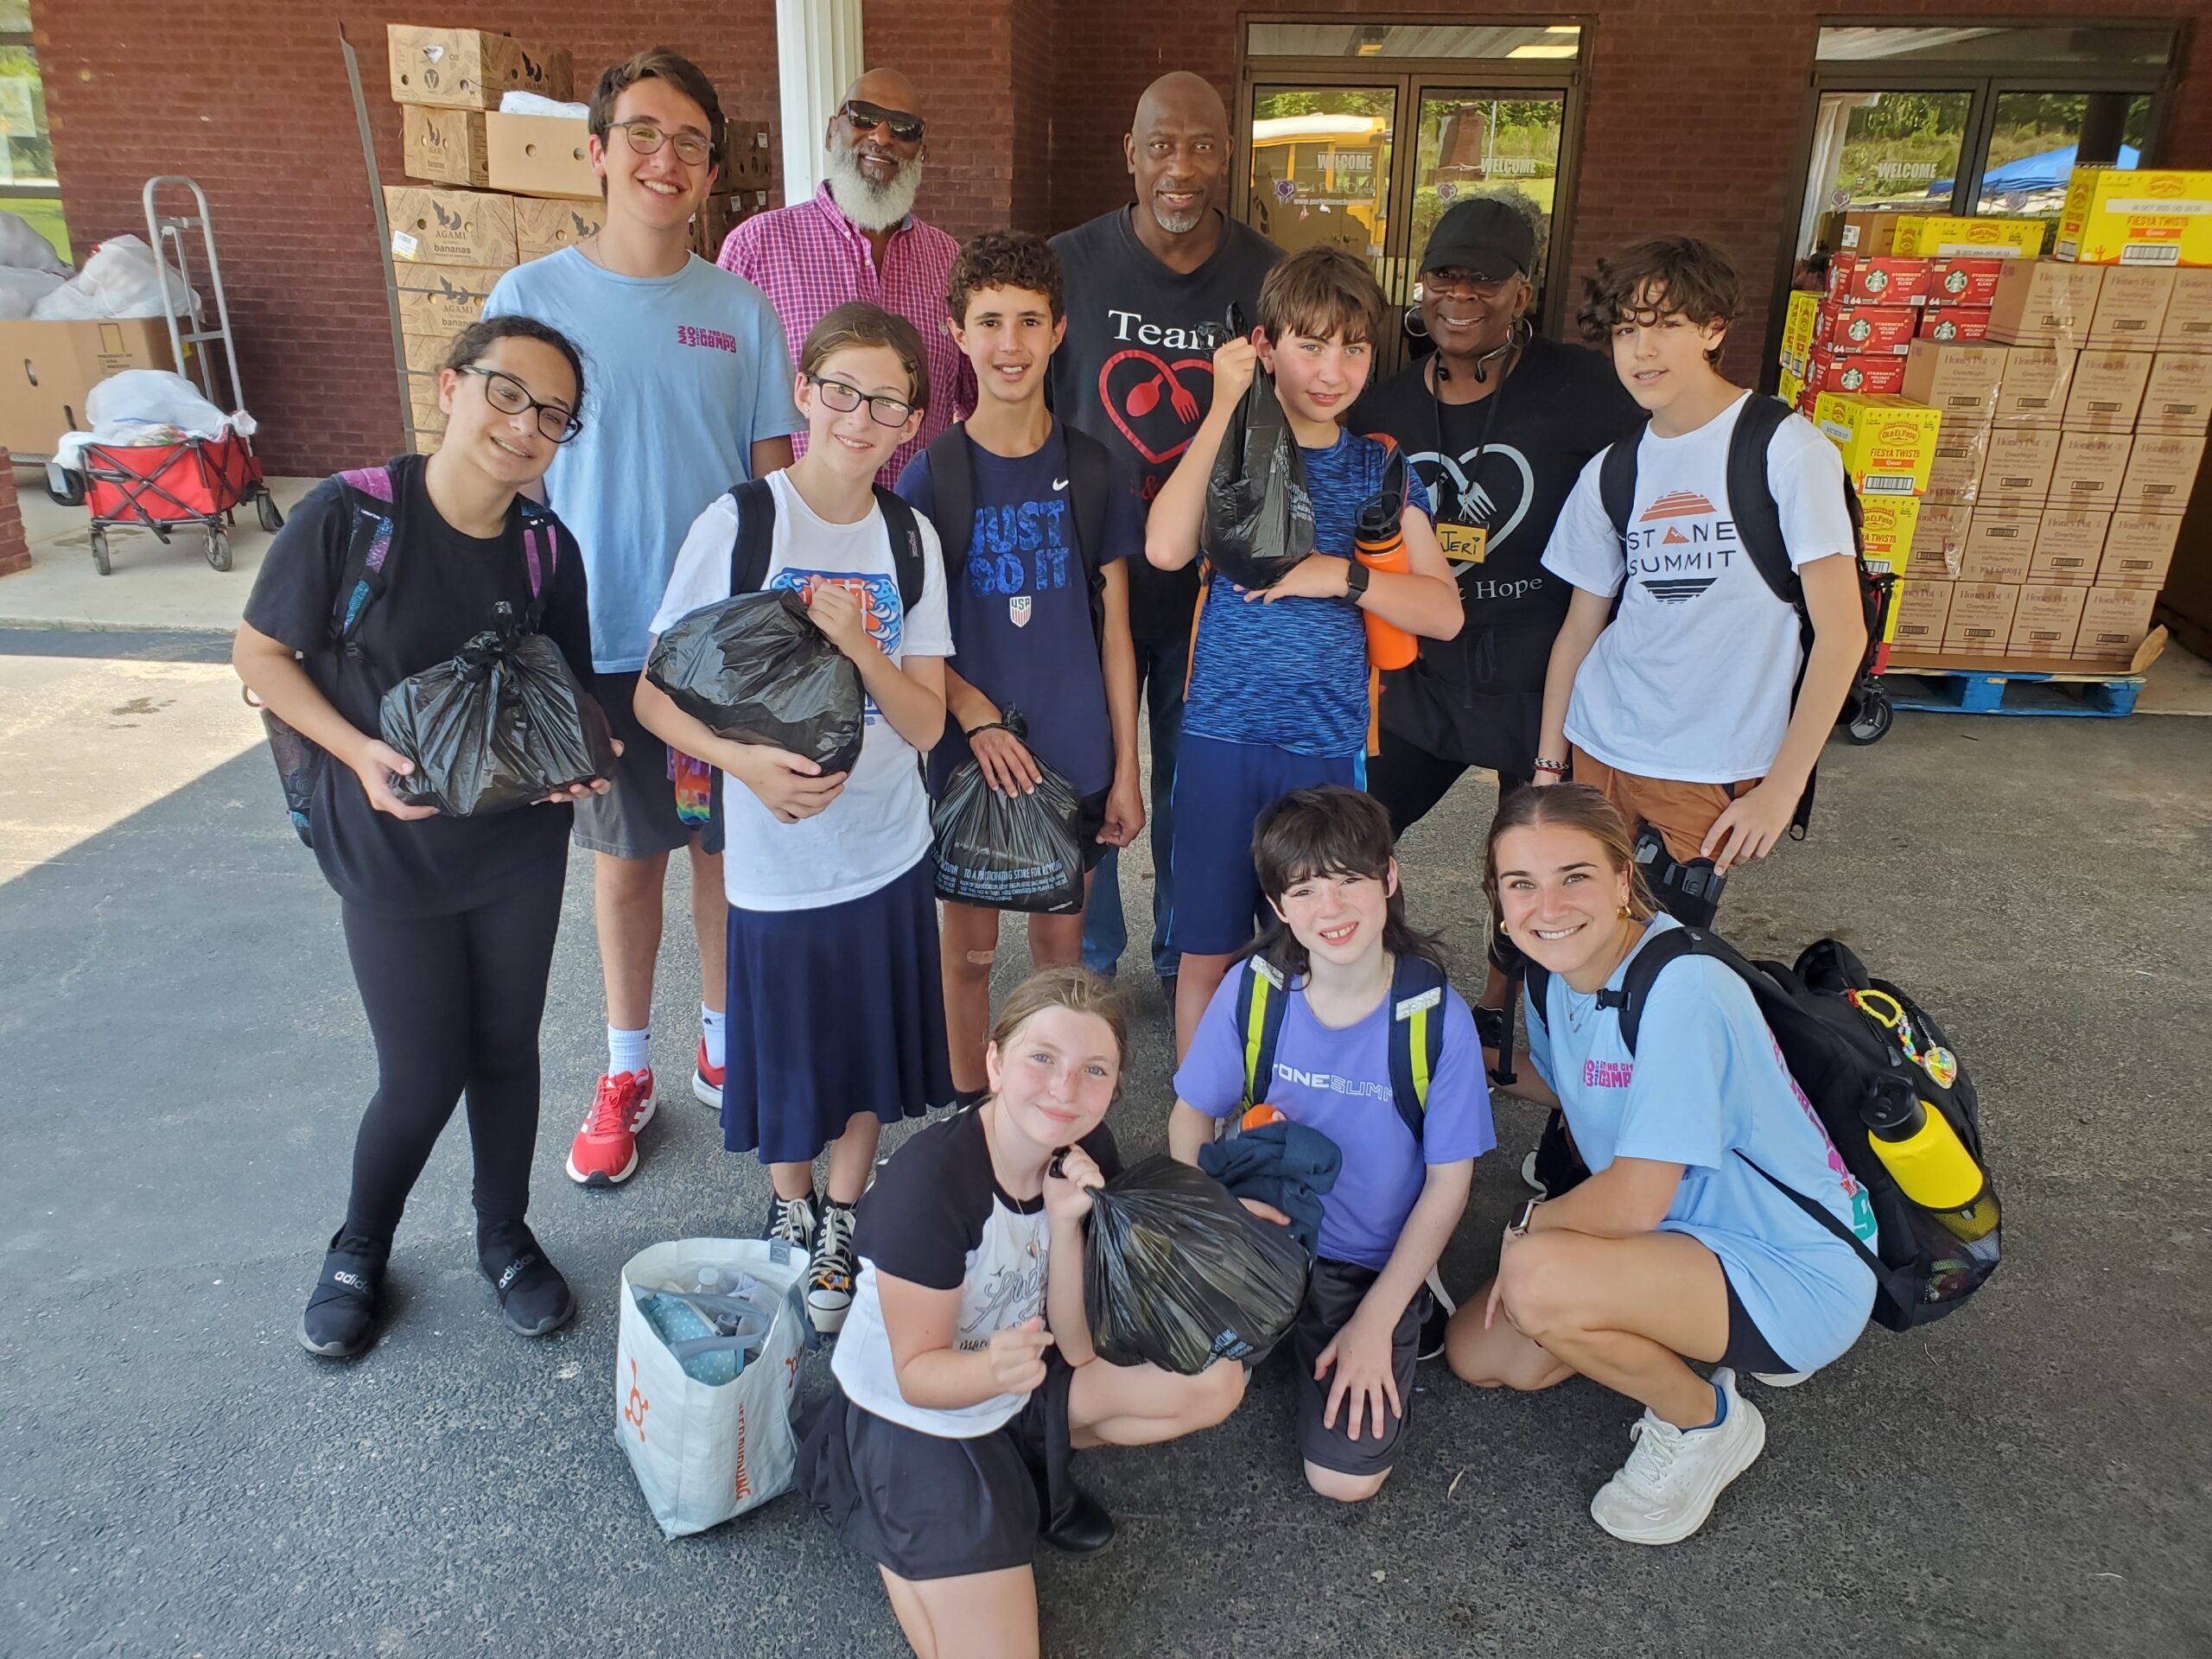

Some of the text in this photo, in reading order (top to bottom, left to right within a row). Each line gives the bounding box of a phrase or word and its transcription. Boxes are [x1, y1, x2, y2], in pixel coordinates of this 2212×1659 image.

[1318, 154, 1372, 170] WELCOME
[1480, 157, 1535, 174] WELCOME
[1878, 162, 1937, 179] WELCOME
[2127, 216, 2157, 226] FIESTA
[435, 231, 467, 239] AGAMI
[434, 244, 471, 254] bananas
[442, 305, 474, 315] AGAMI
[442, 317, 469, 327] banan
[701, 334, 737, 354] CAMPS
[1834, 345, 1845, 353] 64
[1870, 448, 1920, 458] FIESTA TWISTS
[968, 499, 1065, 557] JUST
[1872, 534, 1897, 543] TWISTS
[1629, 550, 1737, 576] SUMMIT
[969, 547, 1070, 596] DO IT
[1474, 577, 1543, 600] Hope
[1011, 597, 1031, 611] USA
[963, 868, 971, 879] TO
[971, 869, 976, 880] A
[1014, 867, 1030, 880] STORE
[1031, 865, 1042, 878] FOR
[1599, 1070, 1631, 1088] CAMP
